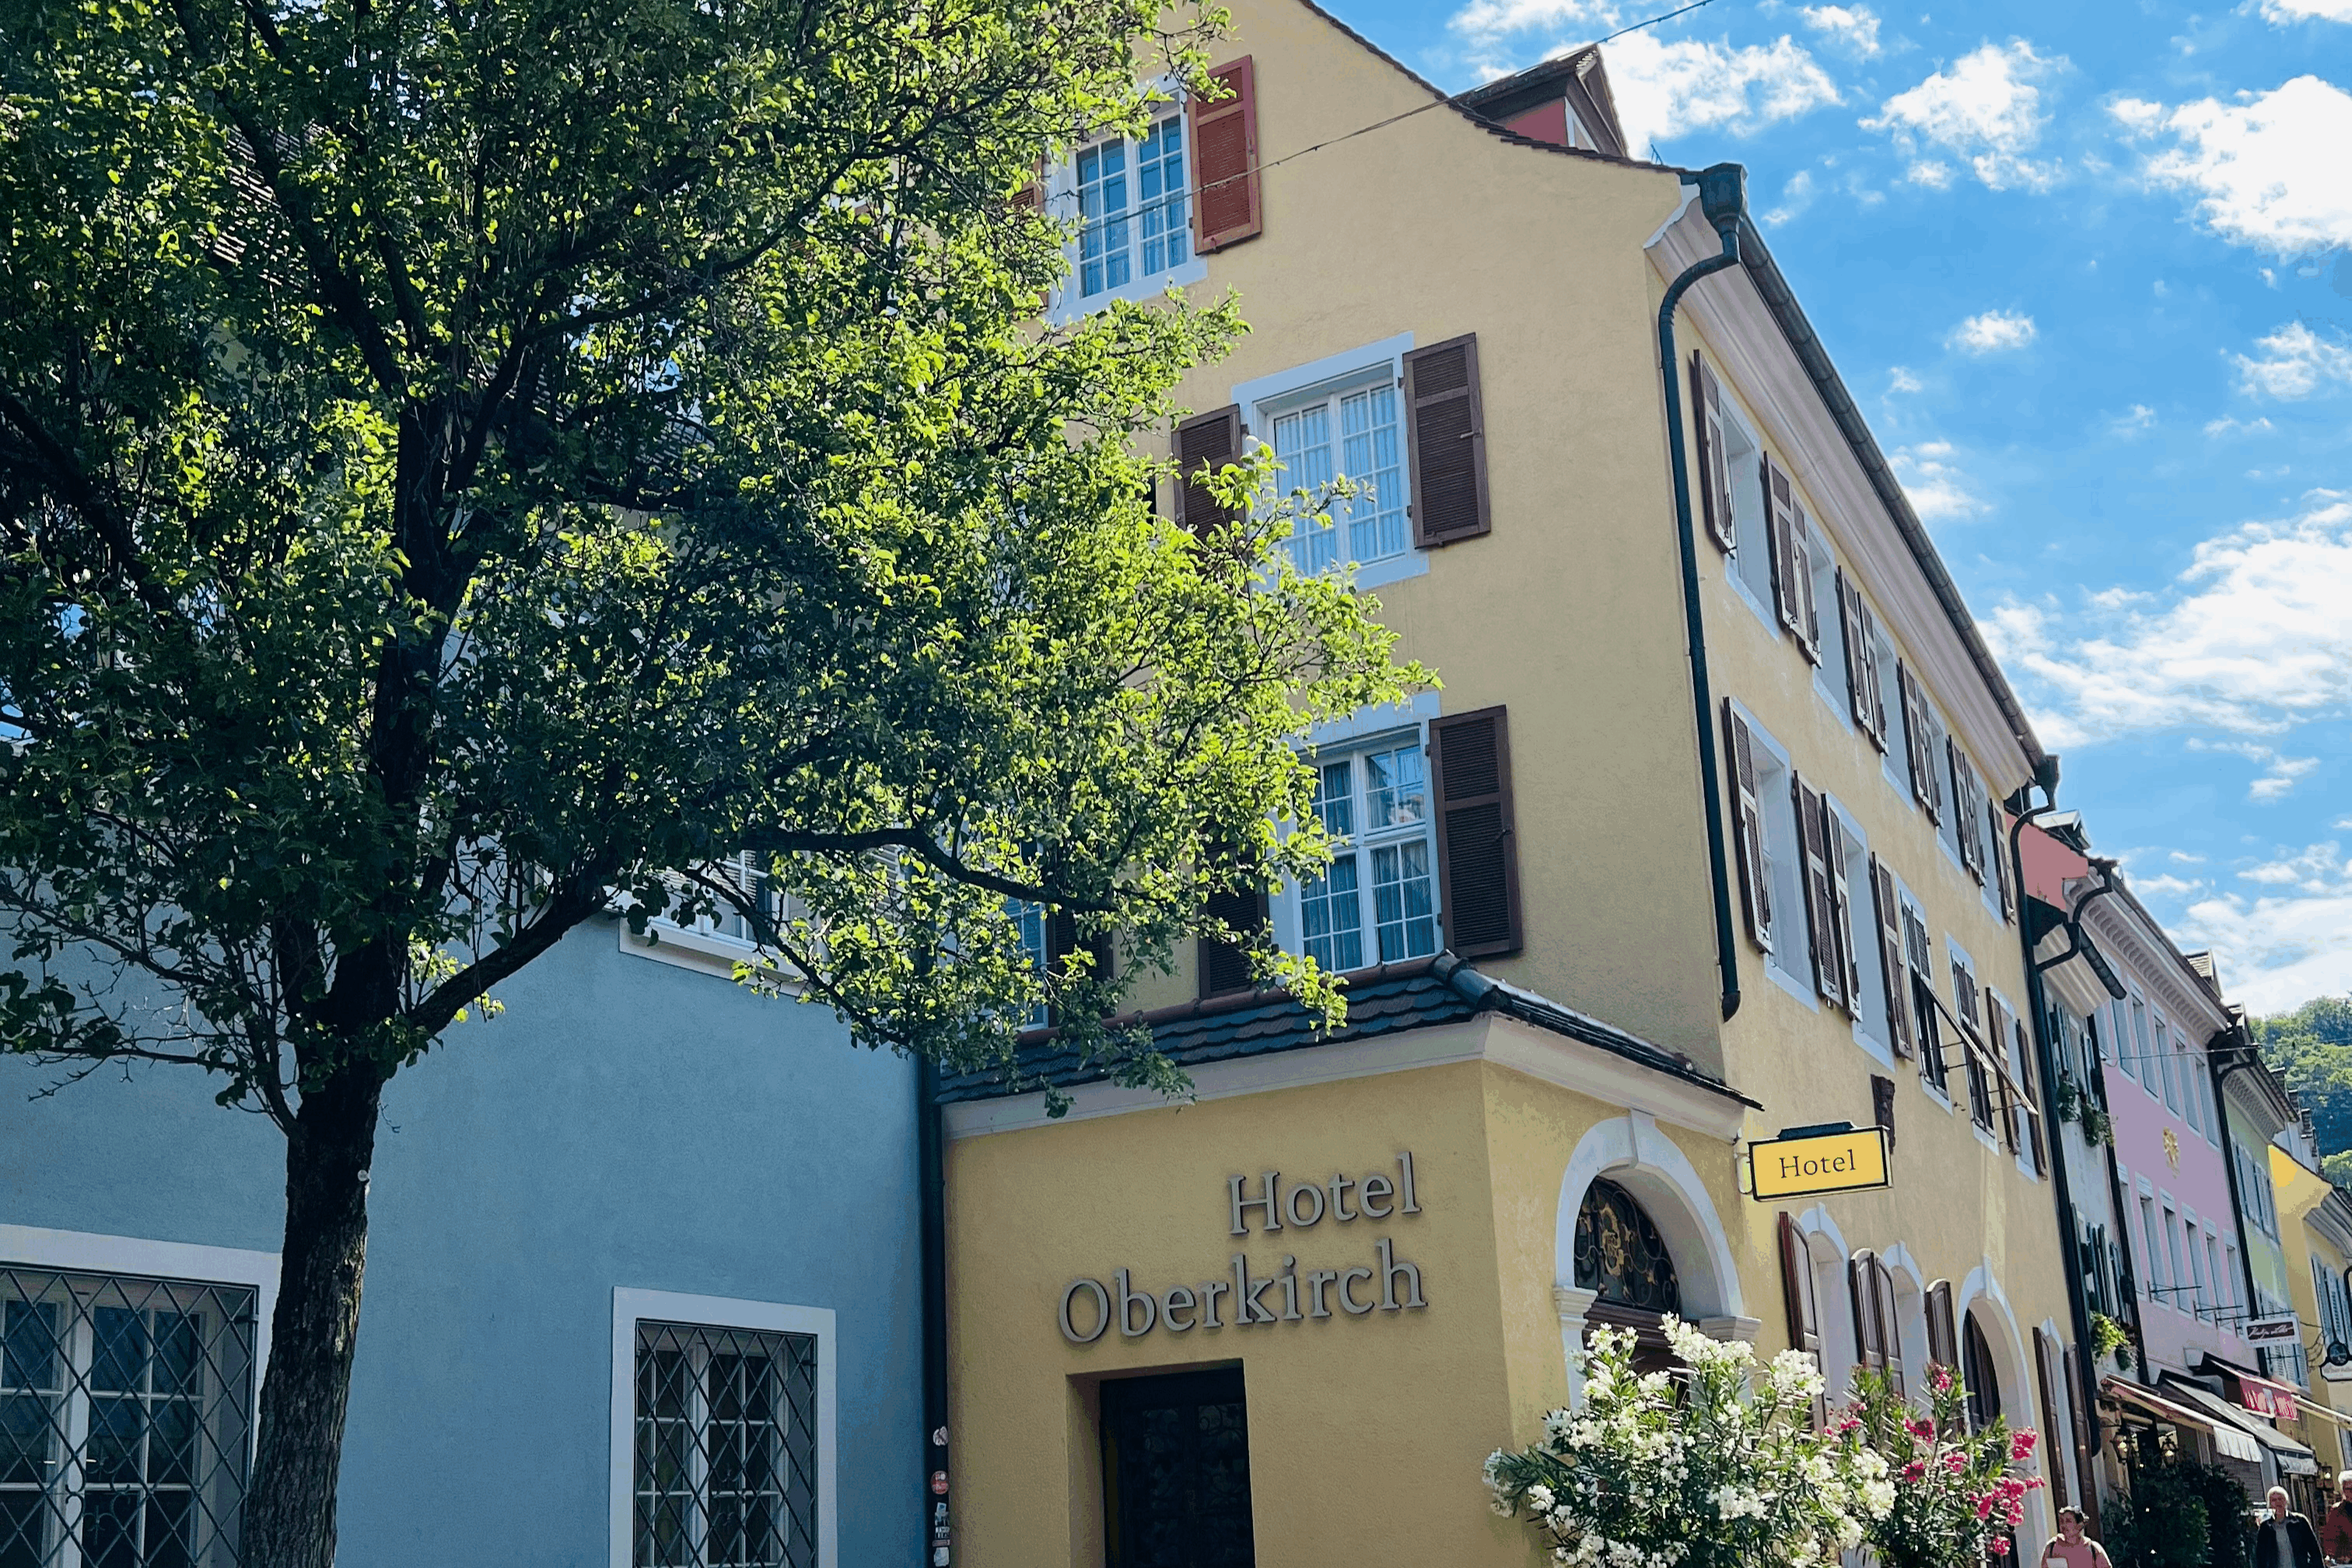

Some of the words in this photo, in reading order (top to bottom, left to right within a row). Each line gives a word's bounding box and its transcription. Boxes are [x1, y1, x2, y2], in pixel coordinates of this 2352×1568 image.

[1227, 1151, 1421, 1234] Hotel
[1779, 1149, 1857, 1178] Hotel
[1059, 1237, 1428, 1342] Oberkirch
